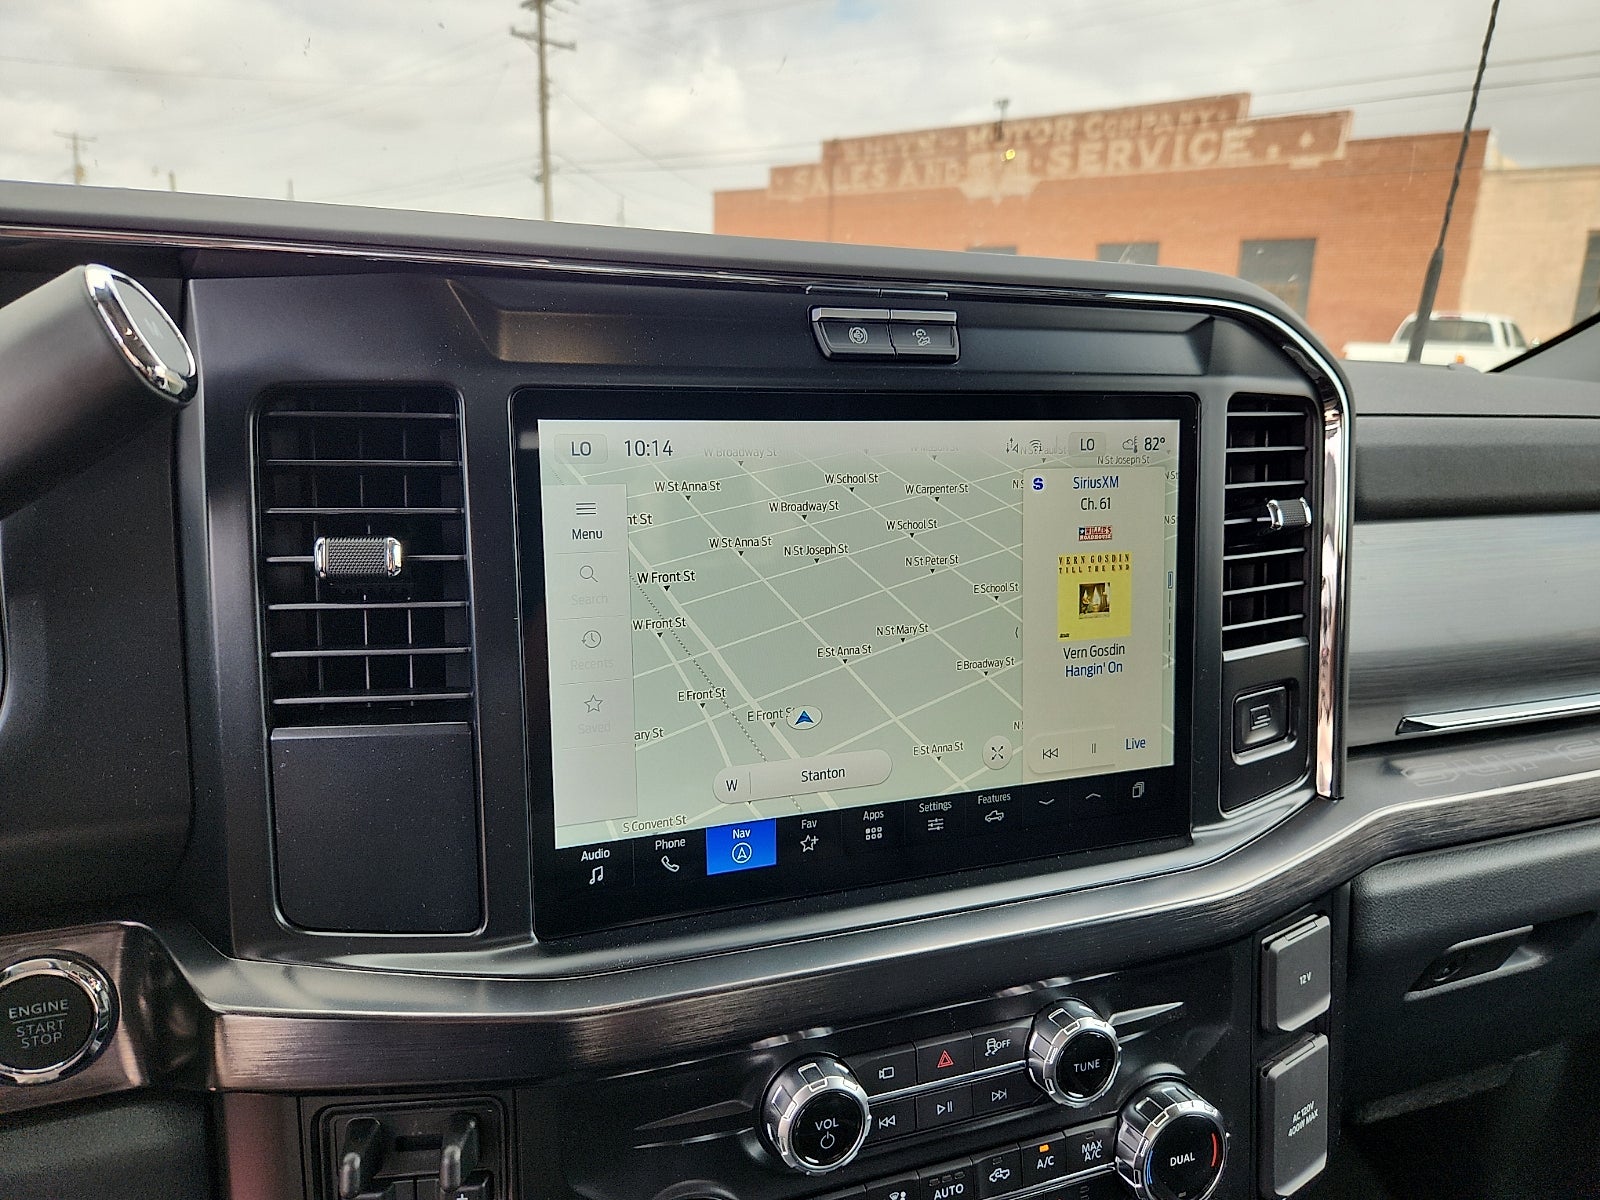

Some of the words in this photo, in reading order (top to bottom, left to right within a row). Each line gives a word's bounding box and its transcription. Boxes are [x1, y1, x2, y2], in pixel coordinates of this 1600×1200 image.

[1047, 126, 1256, 177] SERVICE
[793, 160, 888, 197] SALES
[897, 157, 961, 190] AND
[571, 441, 592, 457] LO
[624, 439, 673, 457] 10:14
[1080, 438, 1095, 451] LO
[1098, 457, 1104, 465] N
[1115, 456, 1141, 466] Joseph
[1142, 455, 1150, 464] St
[825, 474, 836, 484] W
[837, 473, 868, 484] School
[869, 473, 879, 483] St
[1073, 475, 1119, 490] SiriusXM
[655, 481, 666, 492] W
[667, 481, 679, 492] St
[681, 481, 708, 492] Anna
[709, 480, 721, 491] St
[905, 485, 915, 494] W
[916, 484, 957, 496] Carpenter
[958, 483, 969, 493] St
[769, 502, 779, 512] W
[781, 501, 827, 514] Broadway
[829, 500, 840, 511] St
[1081, 498, 1098, 510] Ch.
[1100, 497, 1111, 510] 61
[640, 513, 653, 525] St
[886, 521, 897, 531] W
[898, 520, 926, 530] School
[927, 519, 938, 529] St
[572, 528, 603, 540] Menu
[709, 538, 720, 548] W
[721, 537, 733, 548] St
[734, 537, 759, 548] Anna
[761, 536, 772, 547] St
[784, 546, 792, 556] N
[793, 546, 804, 556] St
[805, 544, 837, 557] Joseph
[838, 543, 849, 554] St
[905, 557, 912, 567] N
[913, 556, 924, 566] St
[925, 556, 948, 566] Peter
[949, 555, 959, 564] St
[1059, 556, 1085, 565] VERN
[1090, 554, 1129, 563] GOSDIN
[637, 572, 649, 583] W
[651, 571, 681, 583] Front
[683, 570, 696, 581] St
[973, 584, 979, 594] E
[979, 583, 1007, 593] School
[1009, 582, 1019, 592] St
[571, 594, 608, 606] Search
[633, 620, 644, 630] W
[645, 618, 673, 629] Front
[674, 617, 687, 628] St
[877, 627, 883, 636] N
[884, 626, 895, 636] St
[896, 625, 918, 637] Mary
[919, 624, 929, 633] St
[817, 648, 824, 658] E
[825, 647, 836, 657] St
[837, 646, 860, 656] Anna
[861, 645, 872, 655] St
[1063, 647, 1087, 660] Vern
[1089, 644, 1126, 658] Gosdin
[570, 659, 614, 671] Recents
[957, 661, 963, 670] E
[963, 658, 1004, 672] Broadway
[1004, 657, 1015, 667] St
[1065, 662, 1107, 678] Hangin'
[1108, 662, 1123, 673] On
[678, 691, 685, 701] E
[686, 689, 714, 700] Front
[715, 688, 726, 699] St
[748, 711, 754, 722] E
[757, 709, 784, 721] Front
[578, 723, 611, 734] Saved
[652, 728, 664, 738] St
[913, 747, 919, 756] E
[920, 746, 931, 755] St
[932, 744, 953, 754] Anna
[954, 742, 964, 752] St
[1126, 737, 1146, 751] Live
[801, 766, 846, 783] Stanton
[726, 779, 738, 792] W
[977, 792, 1011, 805] Features
[919, 800, 952, 814] Settings
[863, 809, 884, 822] Apps
[623, 822, 630, 833] S
[631, 817, 673, 832] Convent
[674, 815, 687, 827] St
[801, 818, 818, 829] Fav
[733, 829, 751, 839] Nav
[655, 837, 686, 851] Phone
[581, 848, 611, 862] Audio
[8, 1000, 69, 1019] ENGINE
[16, 1020, 65, 1038] START
[21, 1032, 62, 1049] STOP
[995, 1038, 1011, 1049] OFF
[1074, 1059, 1101, 1073] TUNE
[1293, 1111, 1301, 1124] AC
[1301, 1100, 1315, 1117] 120V
[815, 1117, 840, 1131] VOL
[1288, 1118, 1306, 1137] 400W
[1305, 1109, 1319, 1125] MAX
[1082, 1140, 1103, 1154] MAX
[1084, 1150, 1102, 1162] A/C
[1170, 1152, 1196, 1167] DUAL
[1037, 1156, 1055, 1170] A/C
[934, 1184, 965, 1200] AUTO
